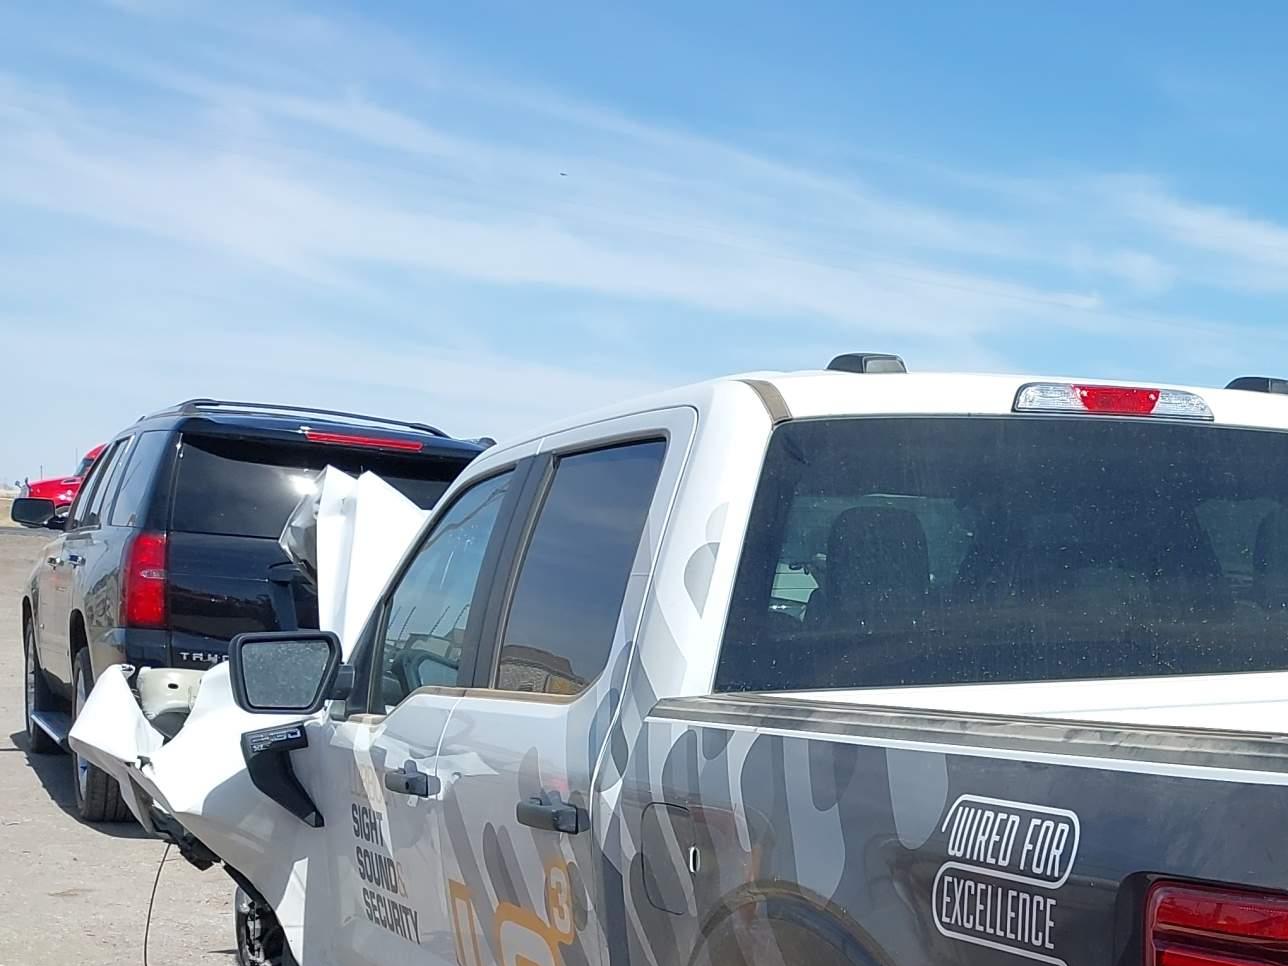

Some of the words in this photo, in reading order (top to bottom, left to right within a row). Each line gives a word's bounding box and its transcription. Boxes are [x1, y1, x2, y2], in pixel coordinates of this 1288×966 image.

[179, 651, 230, 664] TAH
[352, 803, 383, 847] SIGHT
[948, 806, 1020, 867] WIRED
[1020, 818, 1069, 877] FOR
[356, 846, 399, 894] SOUND
[363, 887, 420, 944] SECURITY
[941, 876, 1057, 949] EXCELLENCE
